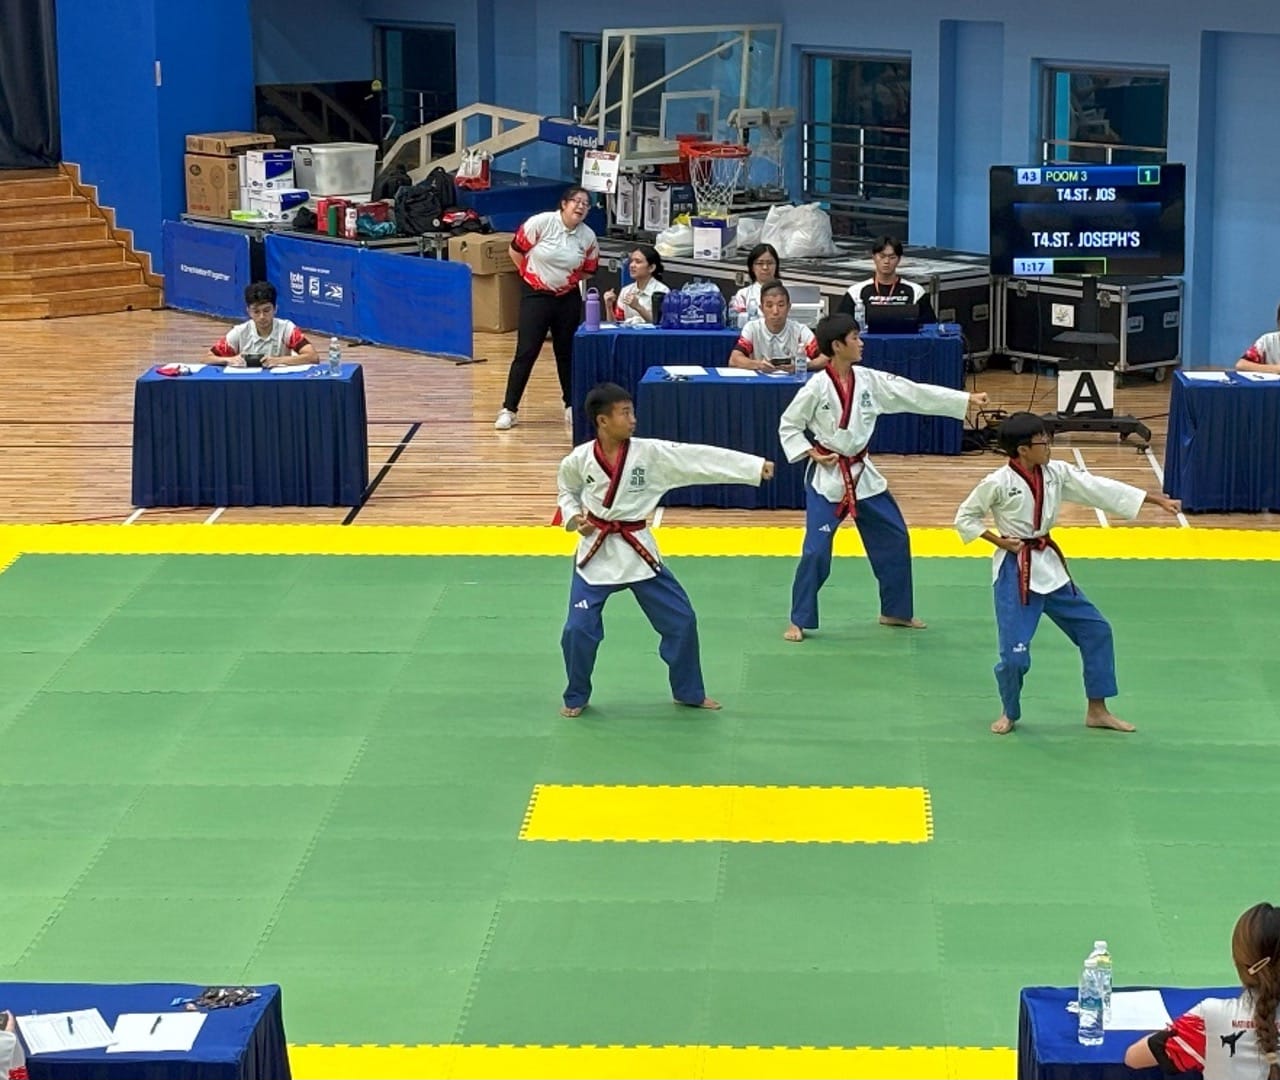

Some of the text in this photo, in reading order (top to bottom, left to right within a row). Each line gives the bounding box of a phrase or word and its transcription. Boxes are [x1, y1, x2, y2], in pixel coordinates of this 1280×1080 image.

[1021, 170, 1151, 183] 43 POOM 3 1
[1095, 188, 1116, 201] JOS
[1077, 231, 1141, 248] JOSEPH'S
[1020, 262, 1045, 272] 1:17
[1065, 371, 1106, 415] A
